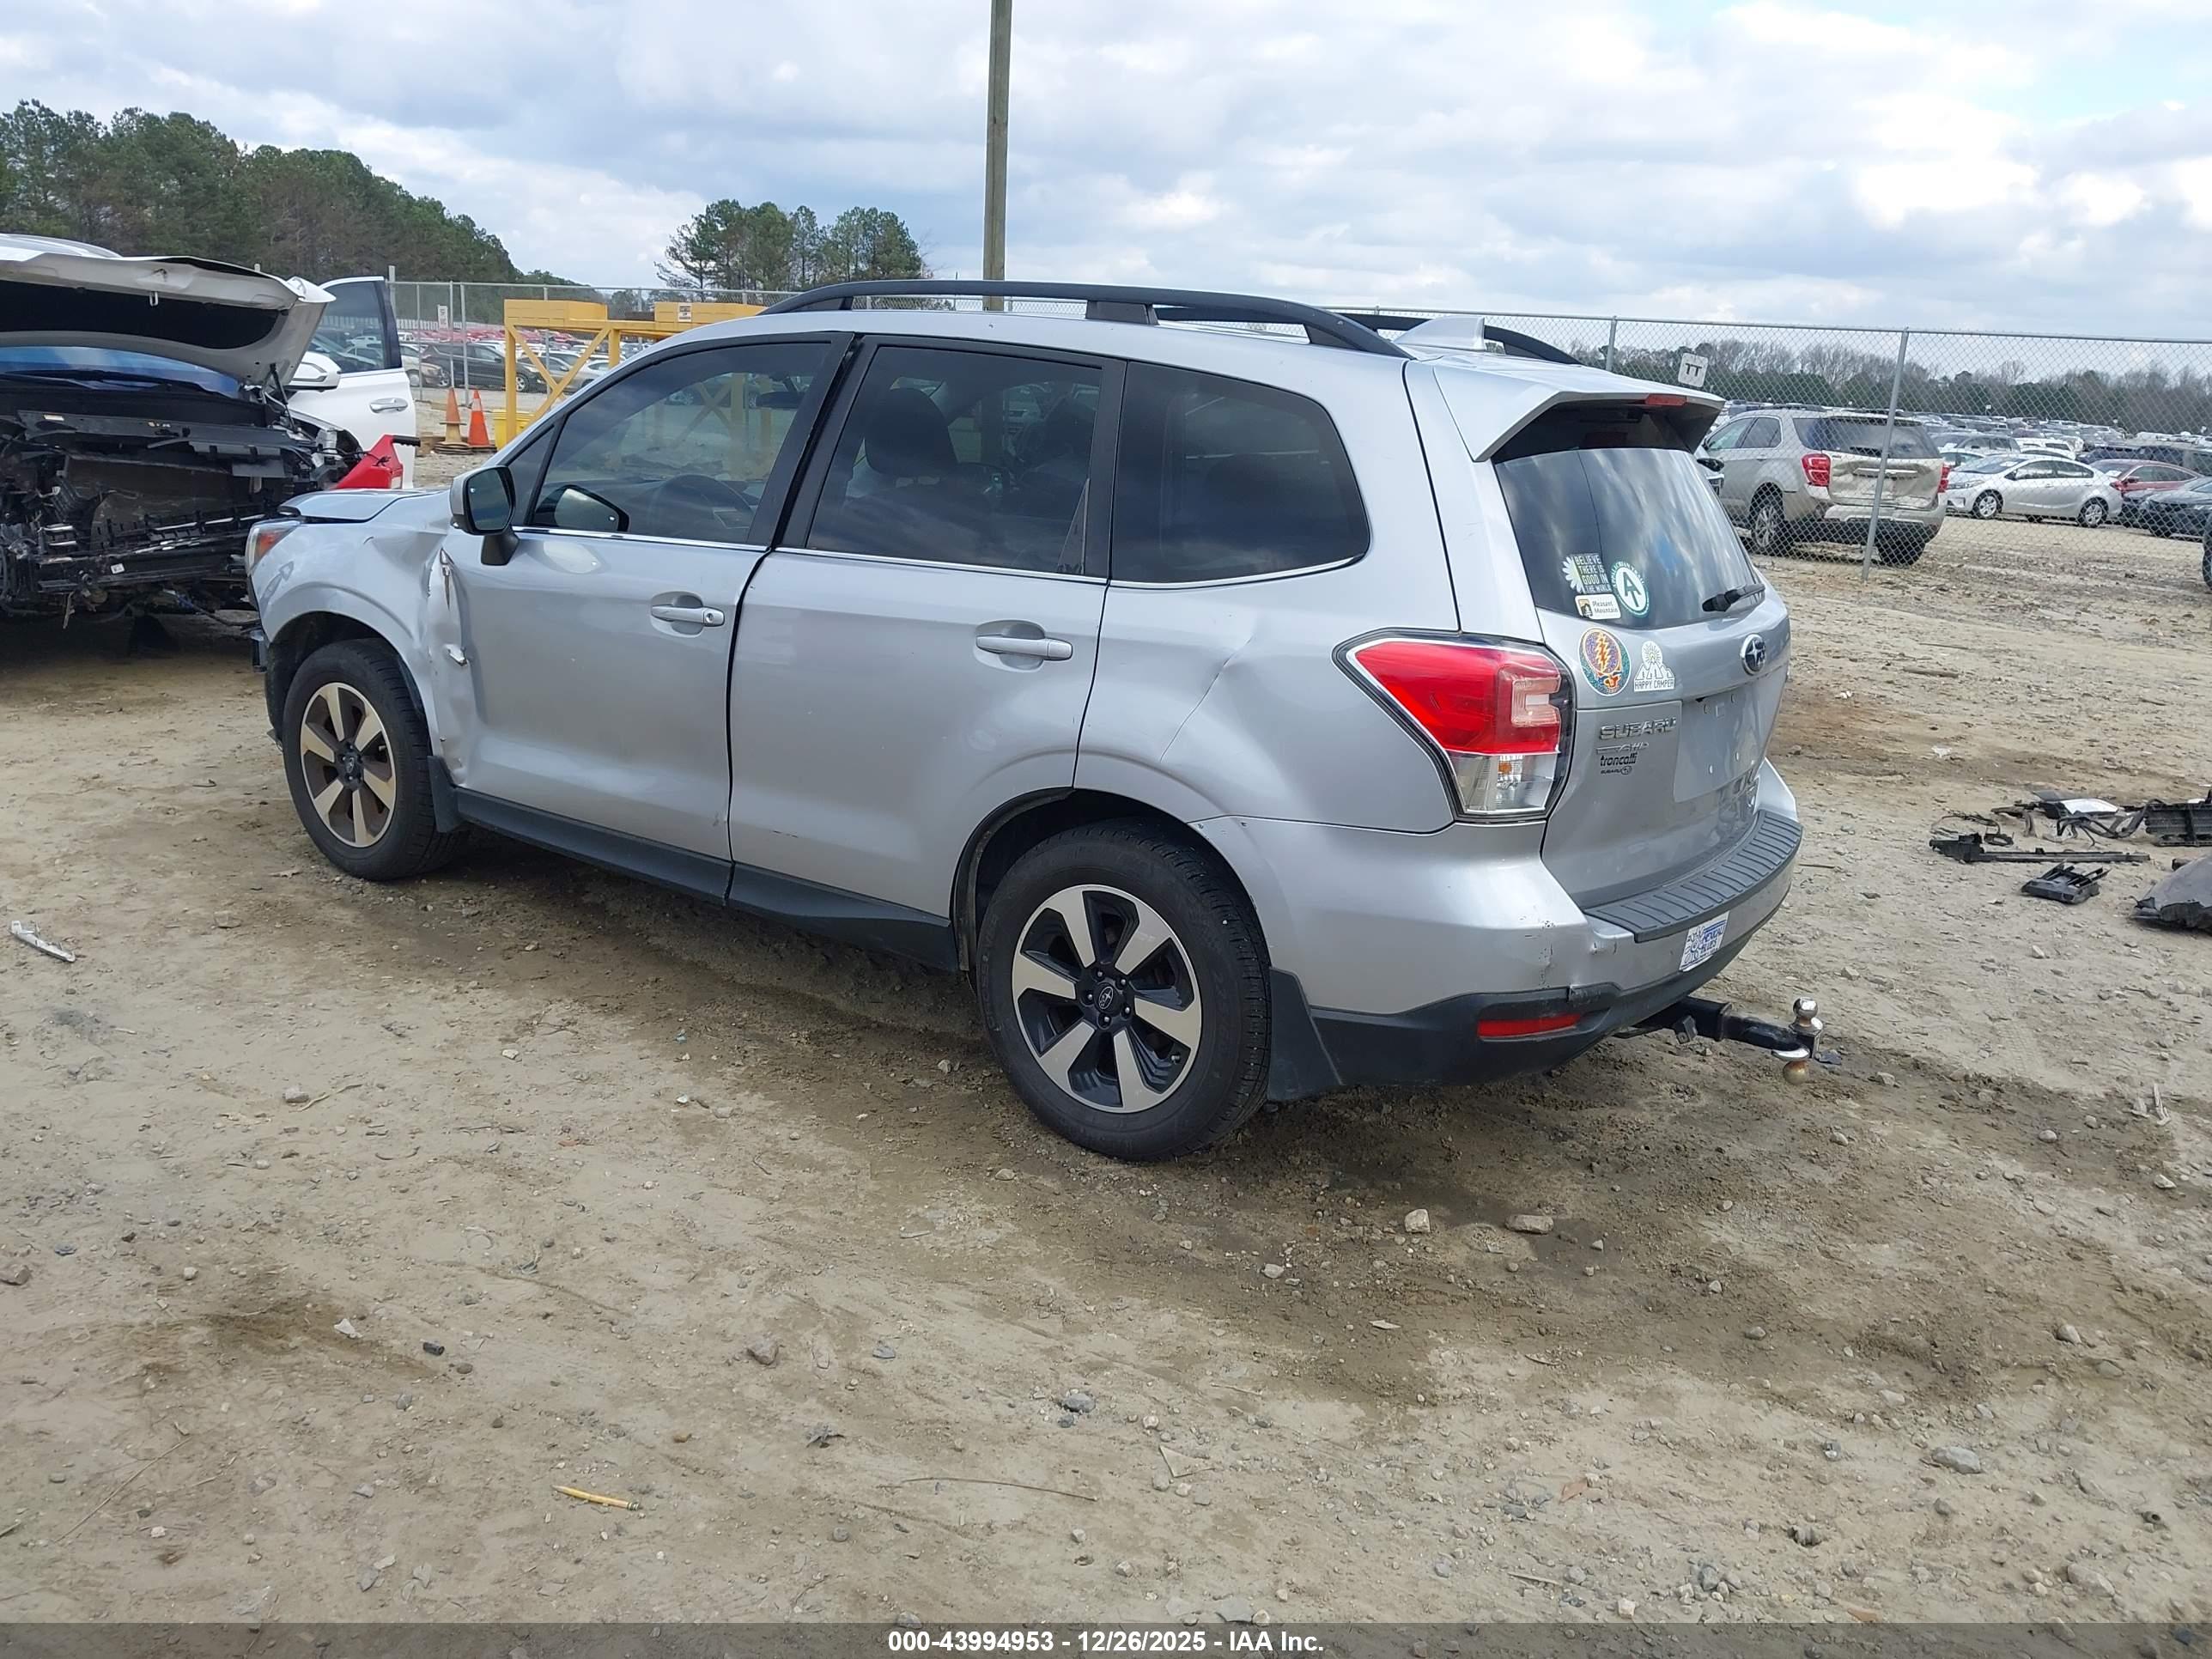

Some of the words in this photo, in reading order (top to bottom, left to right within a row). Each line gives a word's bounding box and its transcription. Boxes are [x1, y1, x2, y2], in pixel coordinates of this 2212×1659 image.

[1685, 362, 1703, 377] TT
[1574, 555, 1602, 565] BELIEVE
[1578, 565, 1599, 574] THERE
[1598, 565, 1605, 574] IS
[1582, 574, 1601, 585] GOOD
[1600, 574, 1610, 584] IN
[1585, 584, 1596, 593] THE
[1634, 679, 1652, 690] HAPPY
[1653, 678, 1674, 689] CAMPER
[1600, 717, 1676, 740] SUBARU
